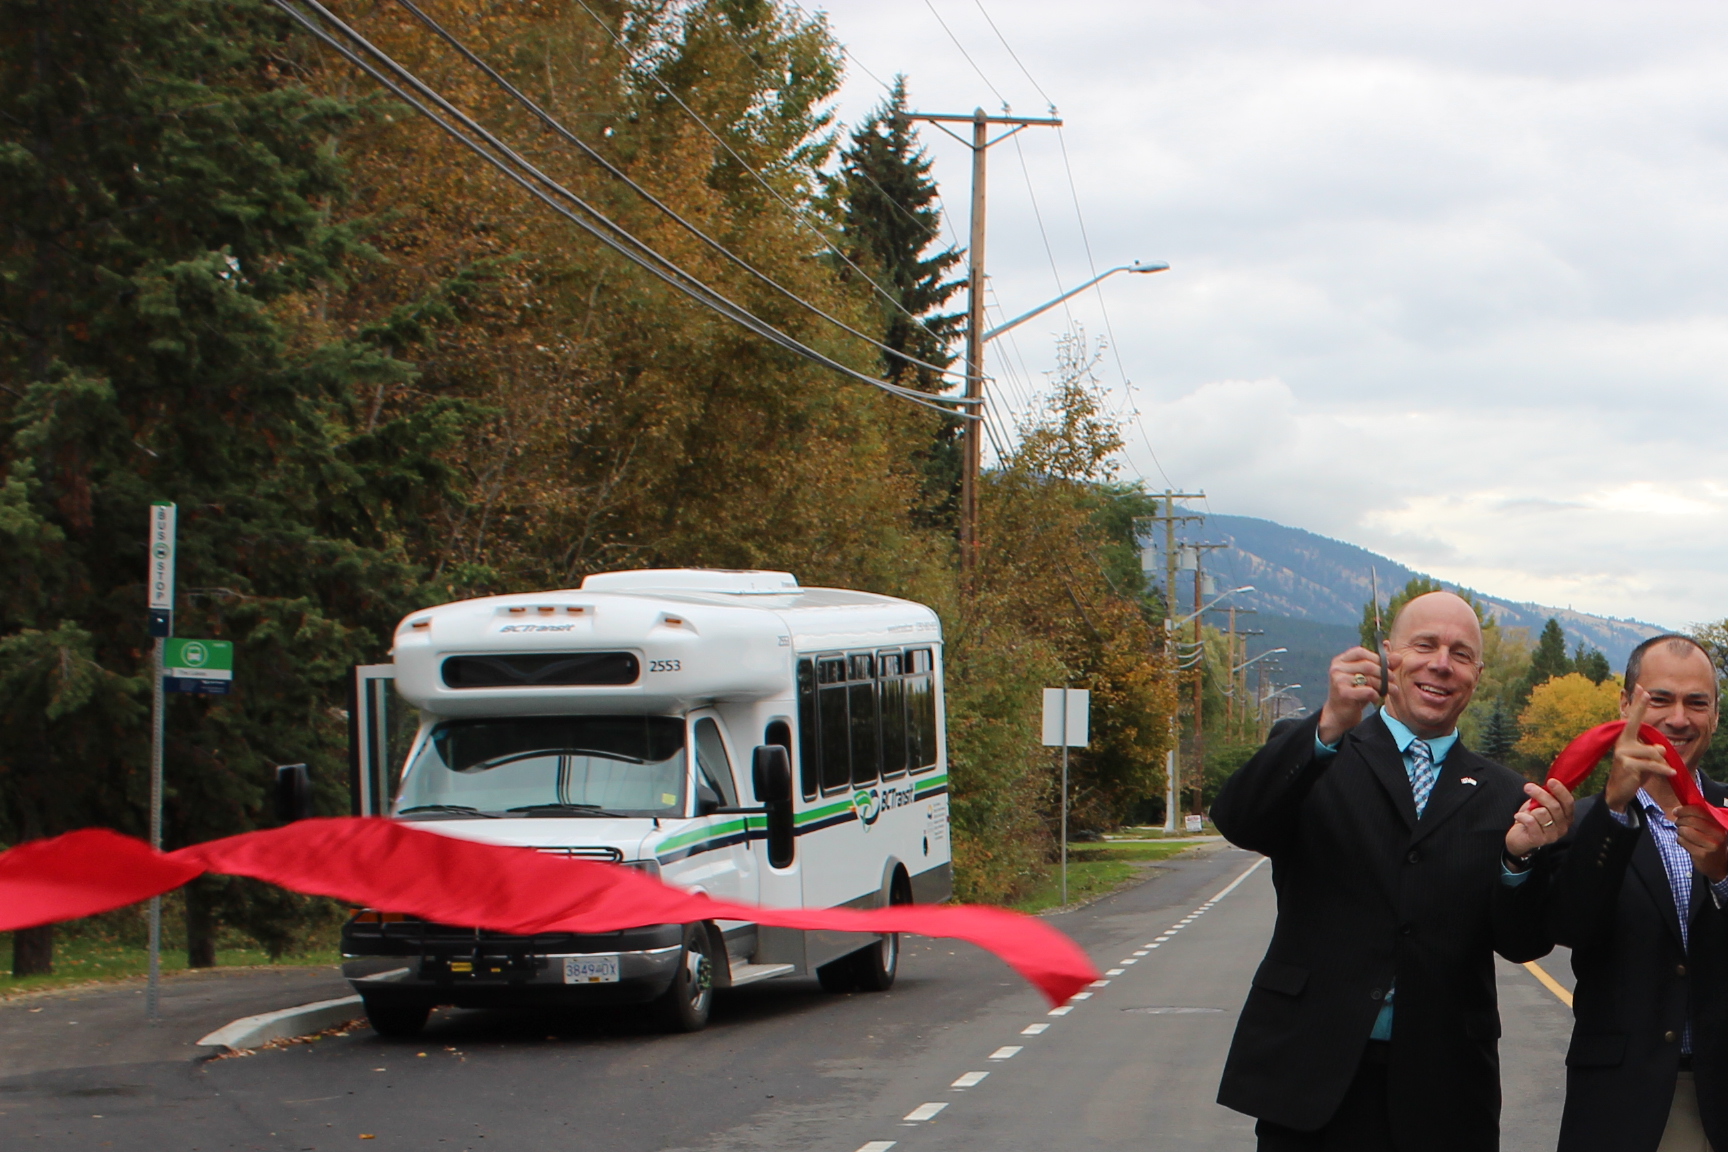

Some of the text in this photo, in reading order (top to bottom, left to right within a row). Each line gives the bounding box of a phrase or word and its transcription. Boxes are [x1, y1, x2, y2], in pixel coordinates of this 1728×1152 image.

[157, 511, 166, 540] BUS
[155, 561, 165, 599] STOP
[650, 660, 681, 672] 2553
